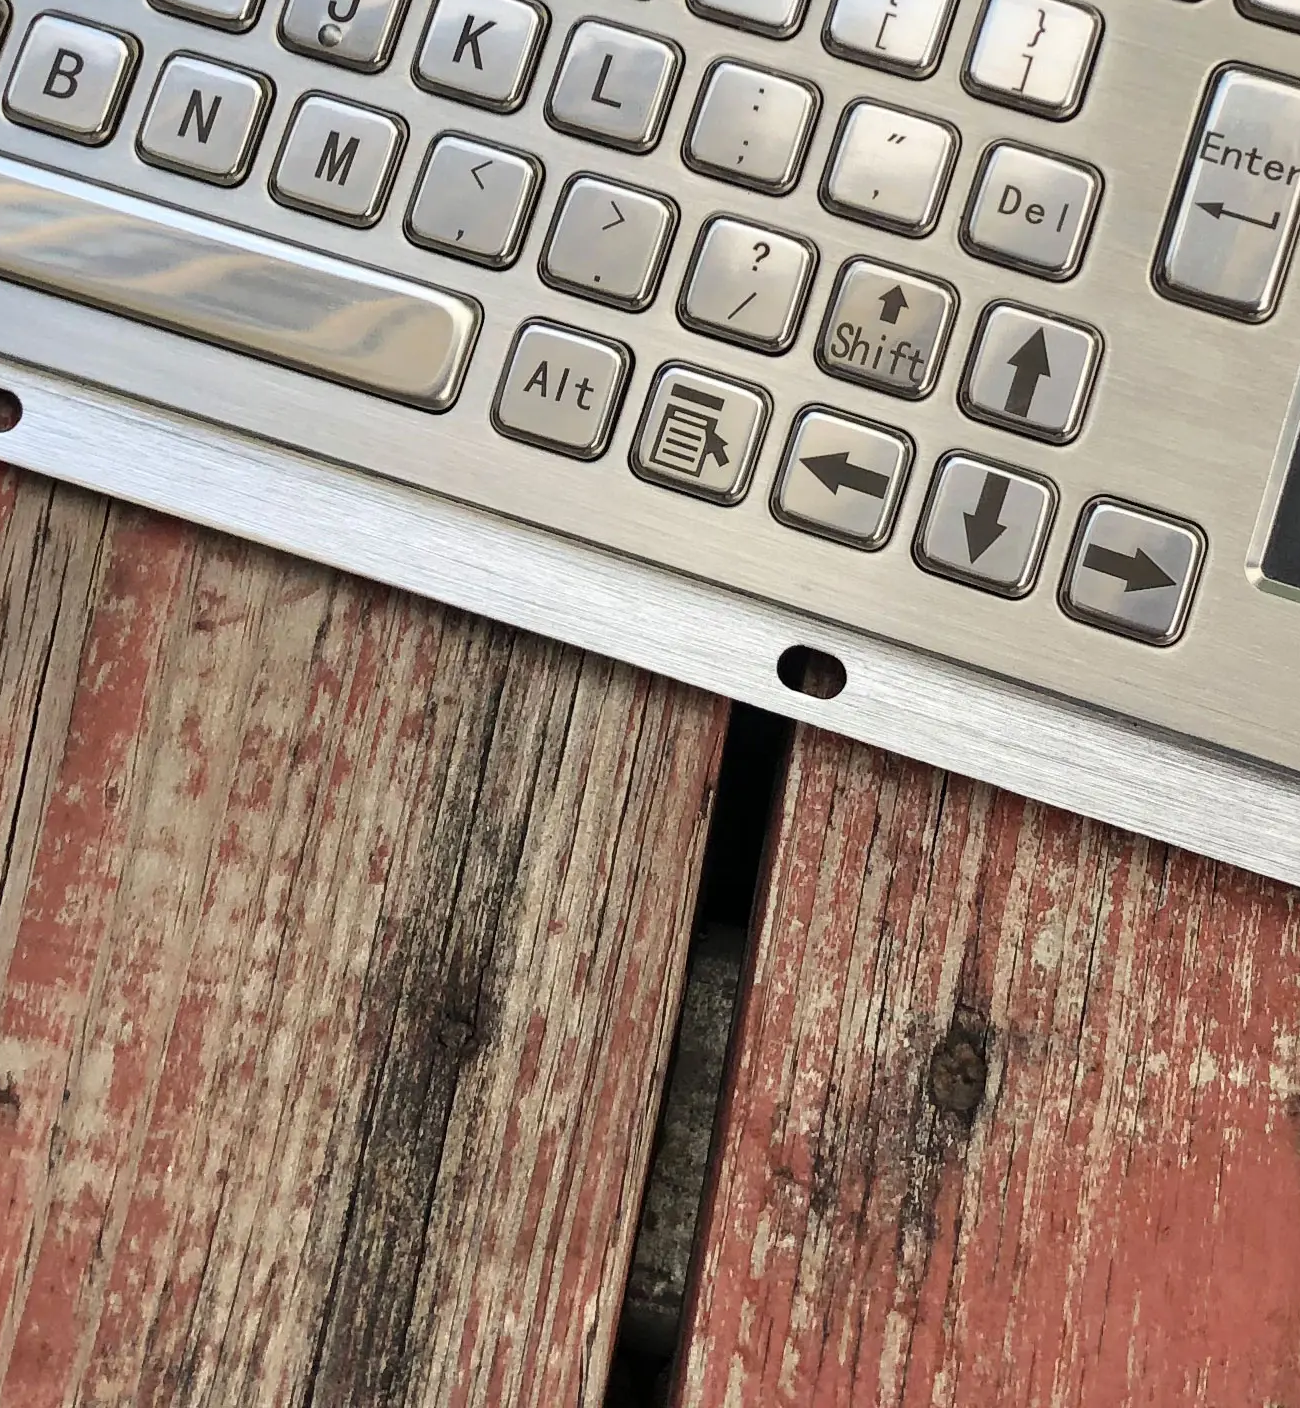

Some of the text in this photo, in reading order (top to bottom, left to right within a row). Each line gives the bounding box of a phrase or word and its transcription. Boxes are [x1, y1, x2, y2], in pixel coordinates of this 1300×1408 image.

[451, 13, 497, 71] K
[874, 12, 898, 50] [
[1026, 8, 1047, 48] }
[42, 47, 86, 100] B
[590, 53, 623, 110] L
[1010, 53, 1034, 93] ]
[177, 88, 223, 145] N
[313, 130, 361, 187] M
[470, 159, 494, 191] <
[601, 200, 626, 231] >
[997, 184, 1071, 234] Del
[750, 241, 772, 273] ?
[727, 291, 758, 321] /
[830, 321, 926, 382] Shift
[522, 359, 596, 411] Alt
